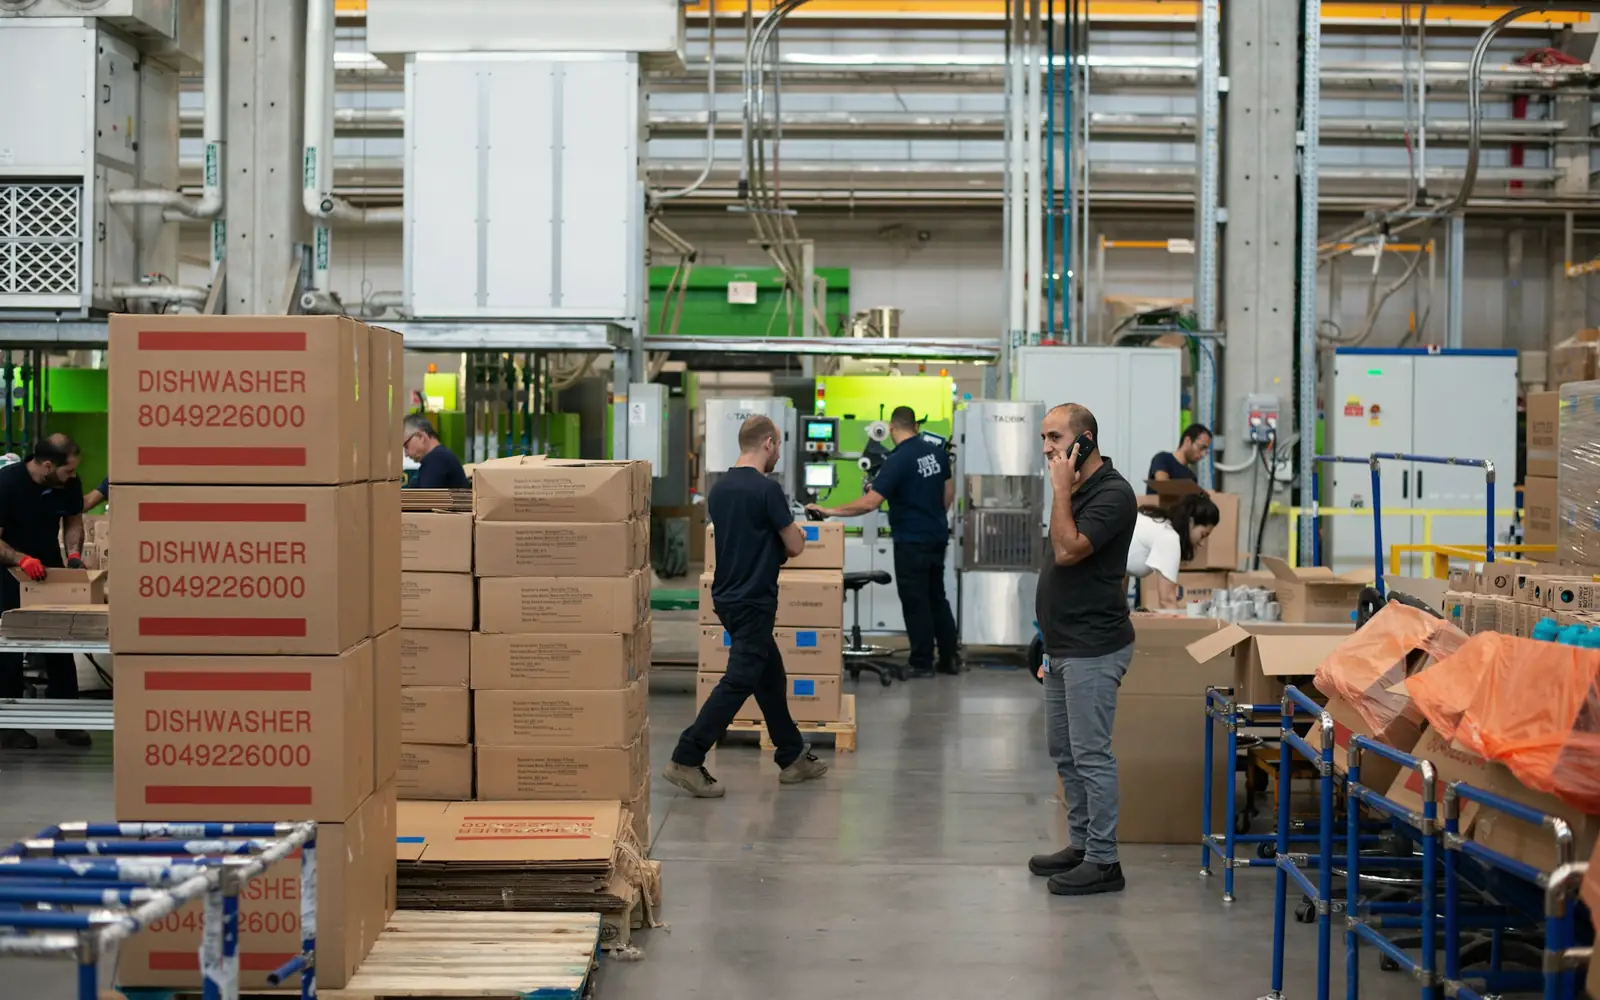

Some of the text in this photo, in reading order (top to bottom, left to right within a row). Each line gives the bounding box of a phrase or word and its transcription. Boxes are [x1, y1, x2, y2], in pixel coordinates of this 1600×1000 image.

[138, 370, 306, 393] DISHWASHER
[138, 404, 305, 428] 8049226000
[139, 541, 306, 564] DISHWASHER
[139, 575, 305, 598] 8049226000
[145, 710, 312, 733] DISHWASHER
[145, 743, 311, 767] 8049226000
